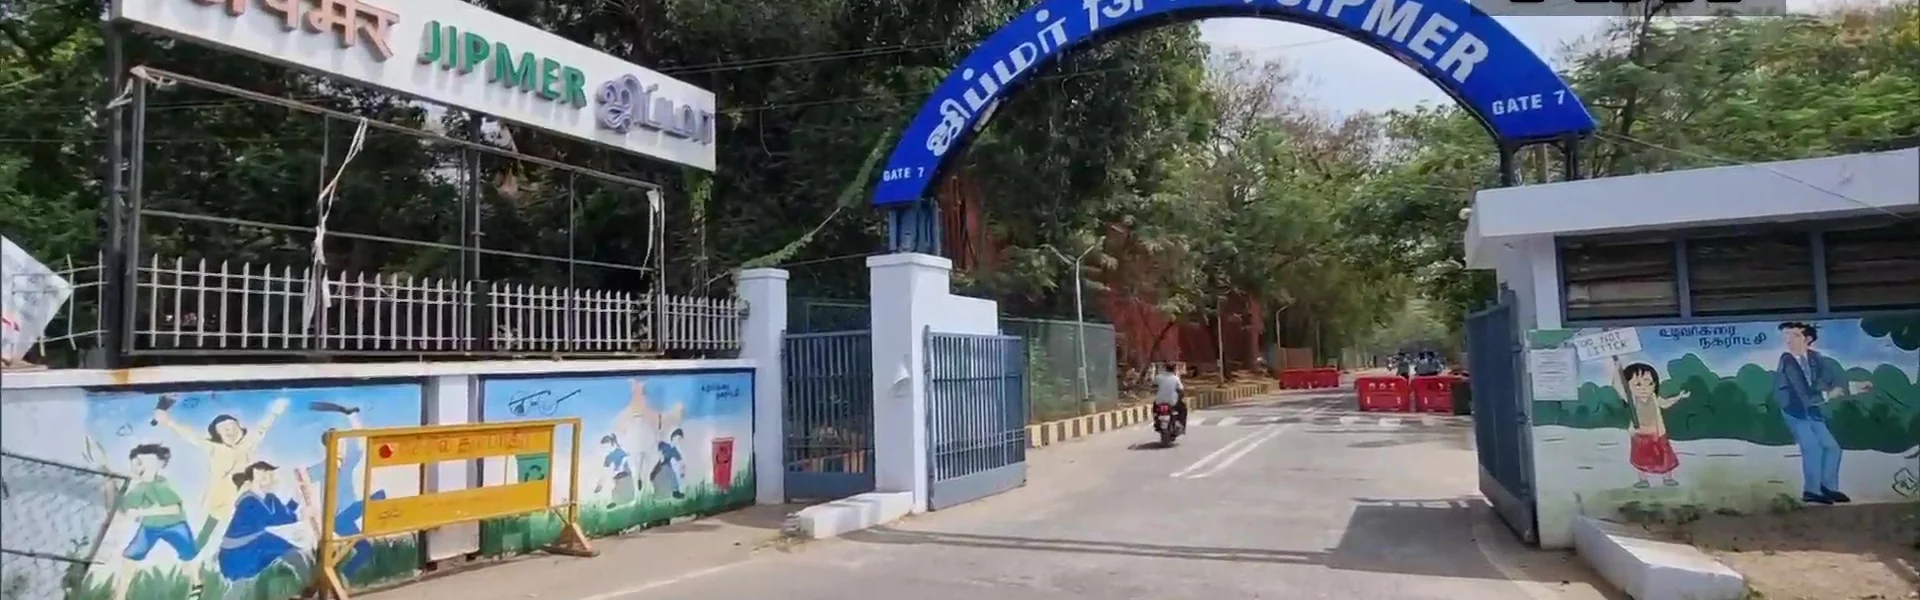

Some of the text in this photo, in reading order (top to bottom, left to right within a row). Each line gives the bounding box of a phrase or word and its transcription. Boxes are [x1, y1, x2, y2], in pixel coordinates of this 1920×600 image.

[417, 20, 587, 109] JIPMER
[926, 9, 1068, 157] ஜிப்மர்
[1492, 89, 1565, 115] GATE 7
[883, 166, 925, 181] GATE 7
